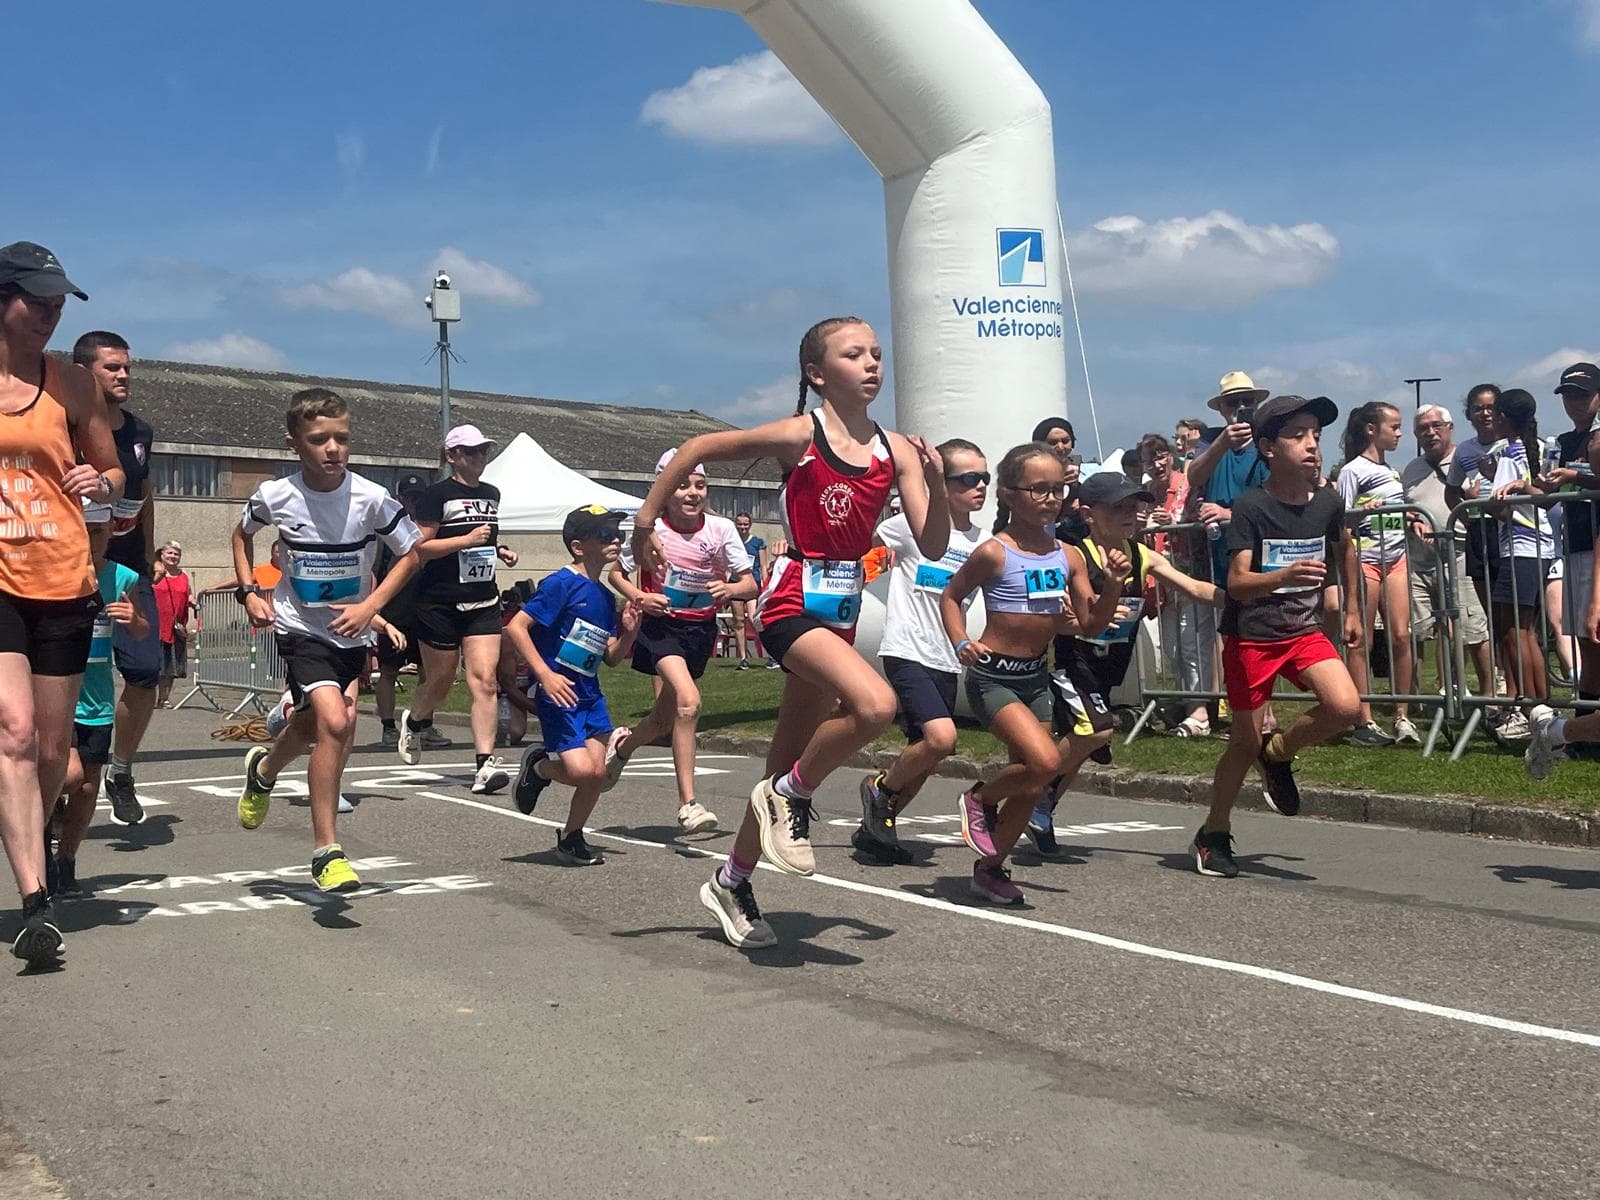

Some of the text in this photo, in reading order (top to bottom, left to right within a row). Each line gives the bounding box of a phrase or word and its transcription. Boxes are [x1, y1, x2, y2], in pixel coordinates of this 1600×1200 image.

[952, 295, 1063, 316] Valencienne
[977, 317, 1061, 340] Métropole
[462, 500, 498, 514] FILA
[1385, 518, 1401, 530] 42
[468, 565, 493, 578] 477
[1030, 569, 1060, 590] 13
[318, 581, 335, 601] 2
[687, 593, 699, 608] 7
[837, 597, 852, 621] 6
[582, 653, 597, 670] 8
[996, 658, 1041, 671] NIKE
